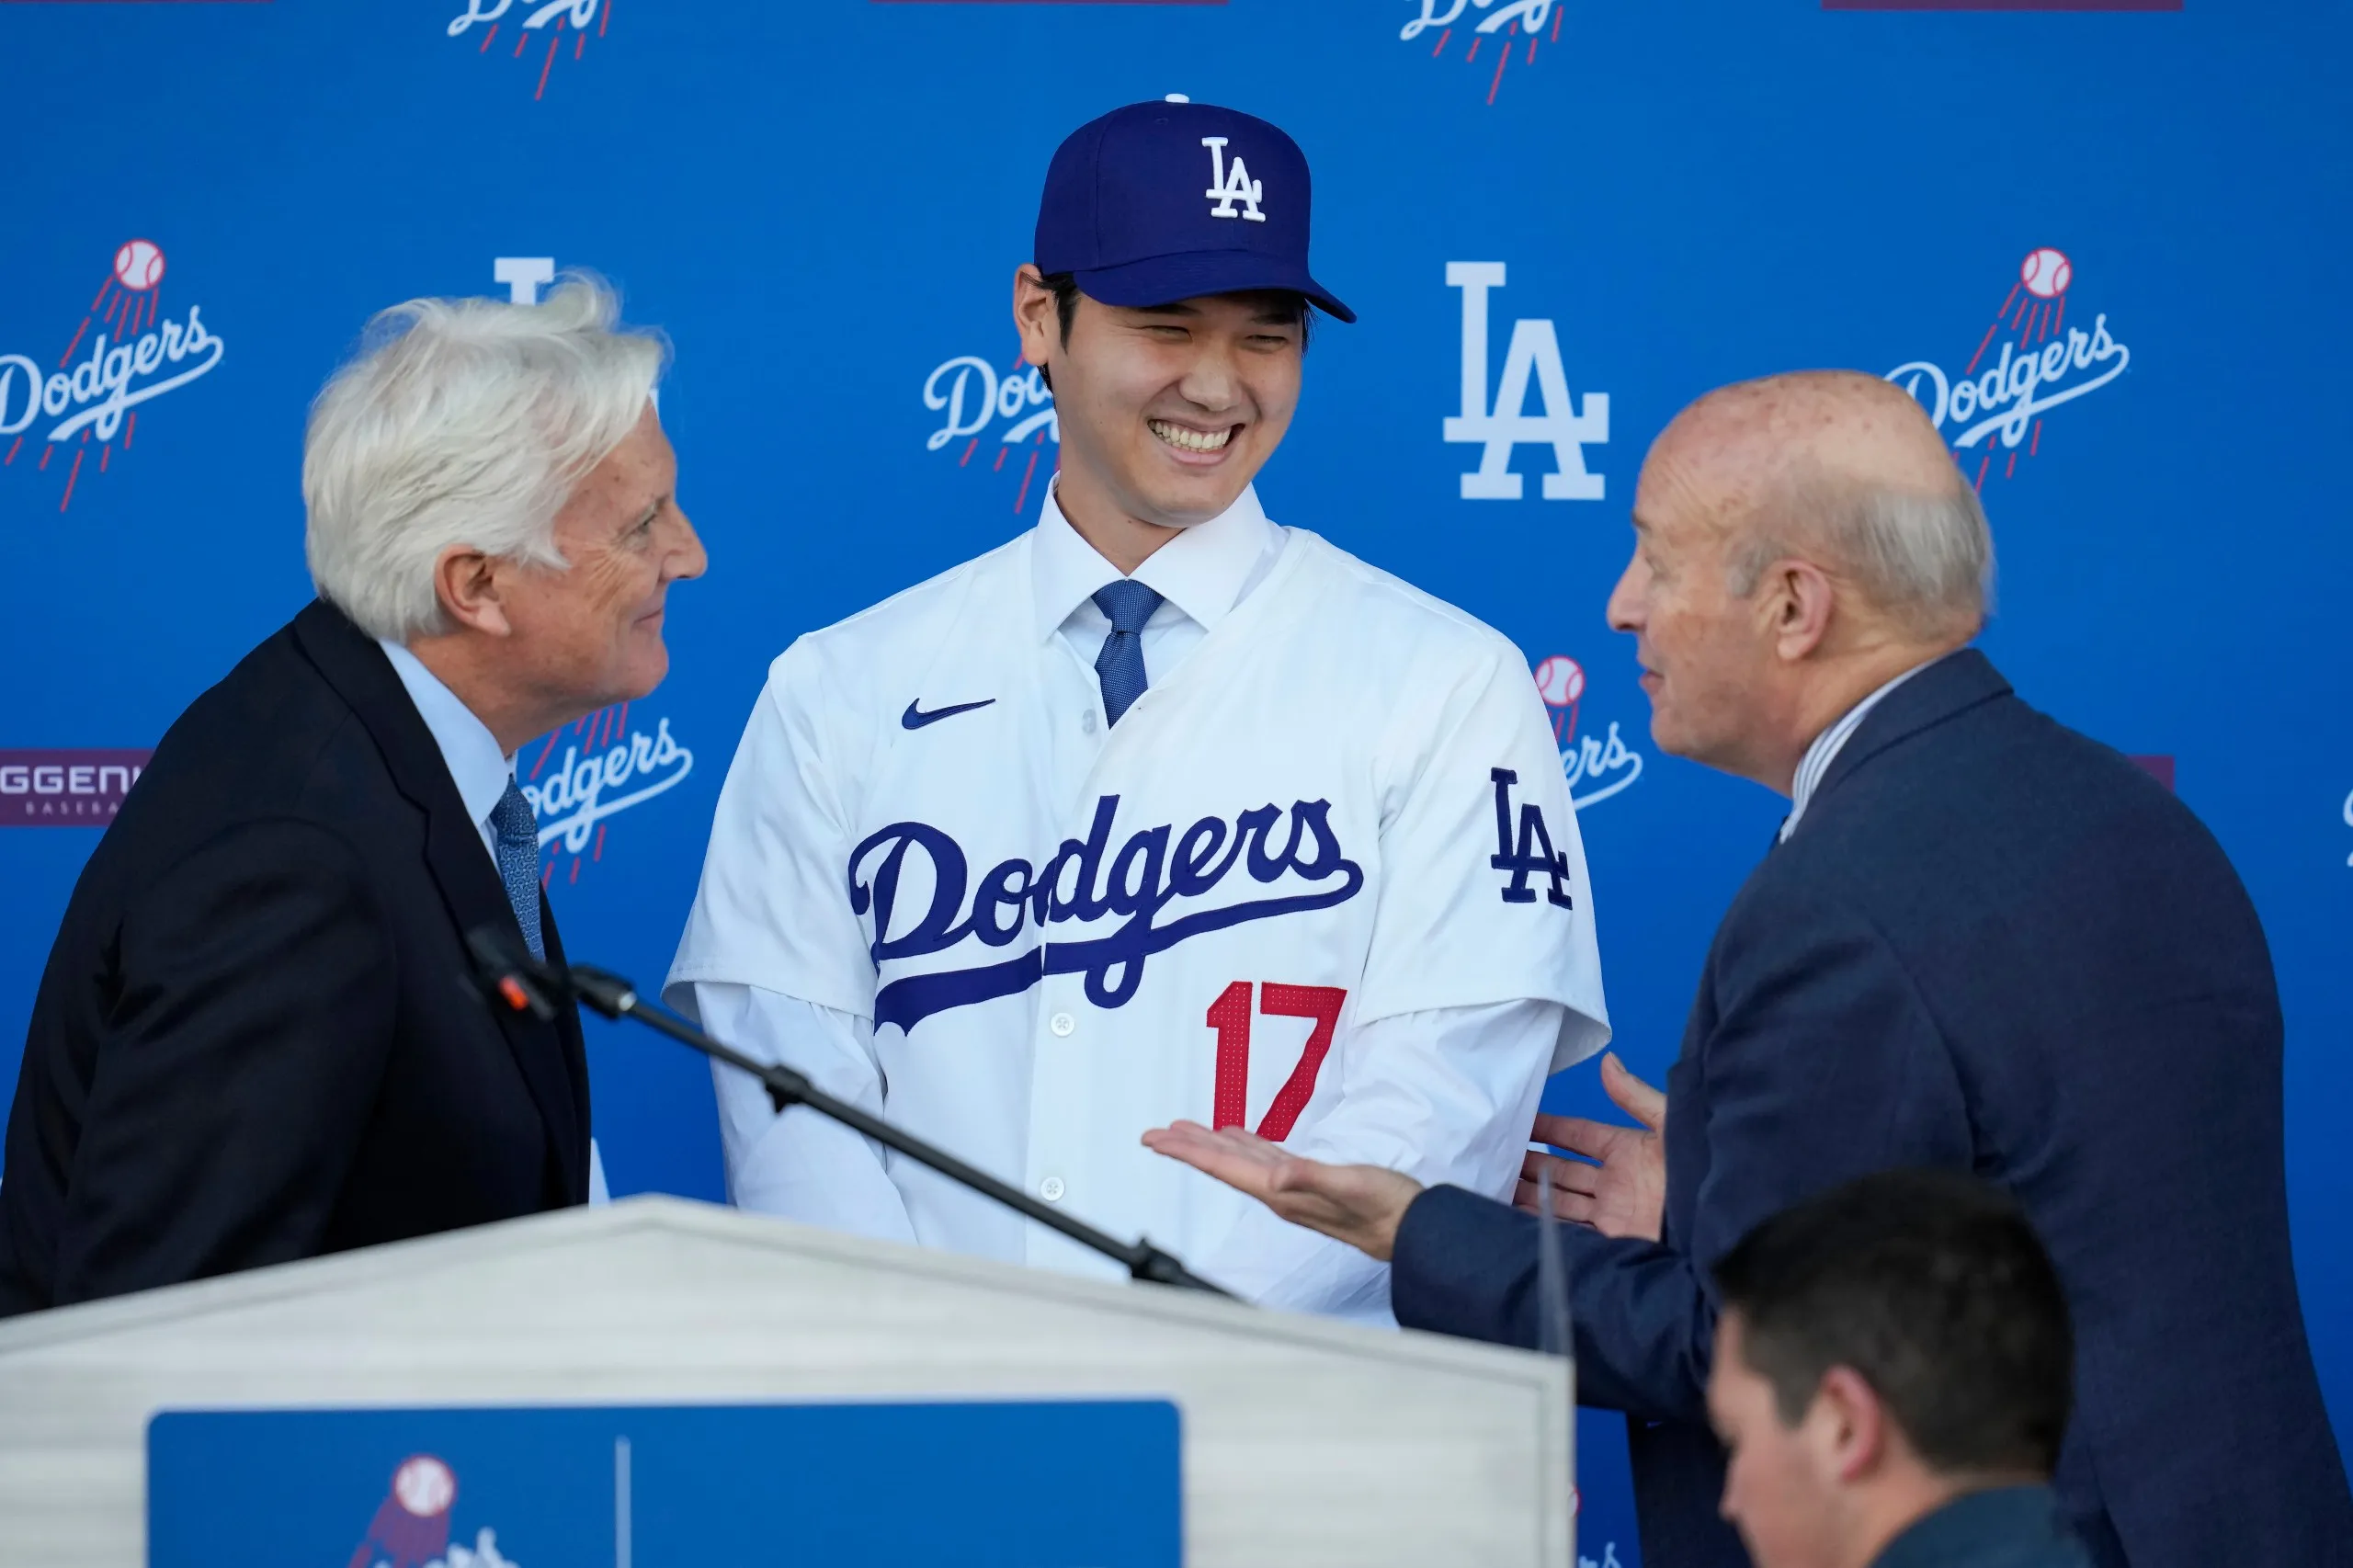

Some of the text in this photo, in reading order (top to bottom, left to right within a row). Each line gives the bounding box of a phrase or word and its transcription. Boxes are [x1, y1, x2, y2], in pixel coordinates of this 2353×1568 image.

[1201, 136, 1266, 222] LA
[0, 304, 223, 442] Dodgers
[1443, 261, 1609, 501] LA
[26, 801, 119, 815] BASEBA
[1490, 767, 1573, 911] LA
[848, 794, 1363, 1037] Dodgers
[1206, 980, 1348, 1142] 17
